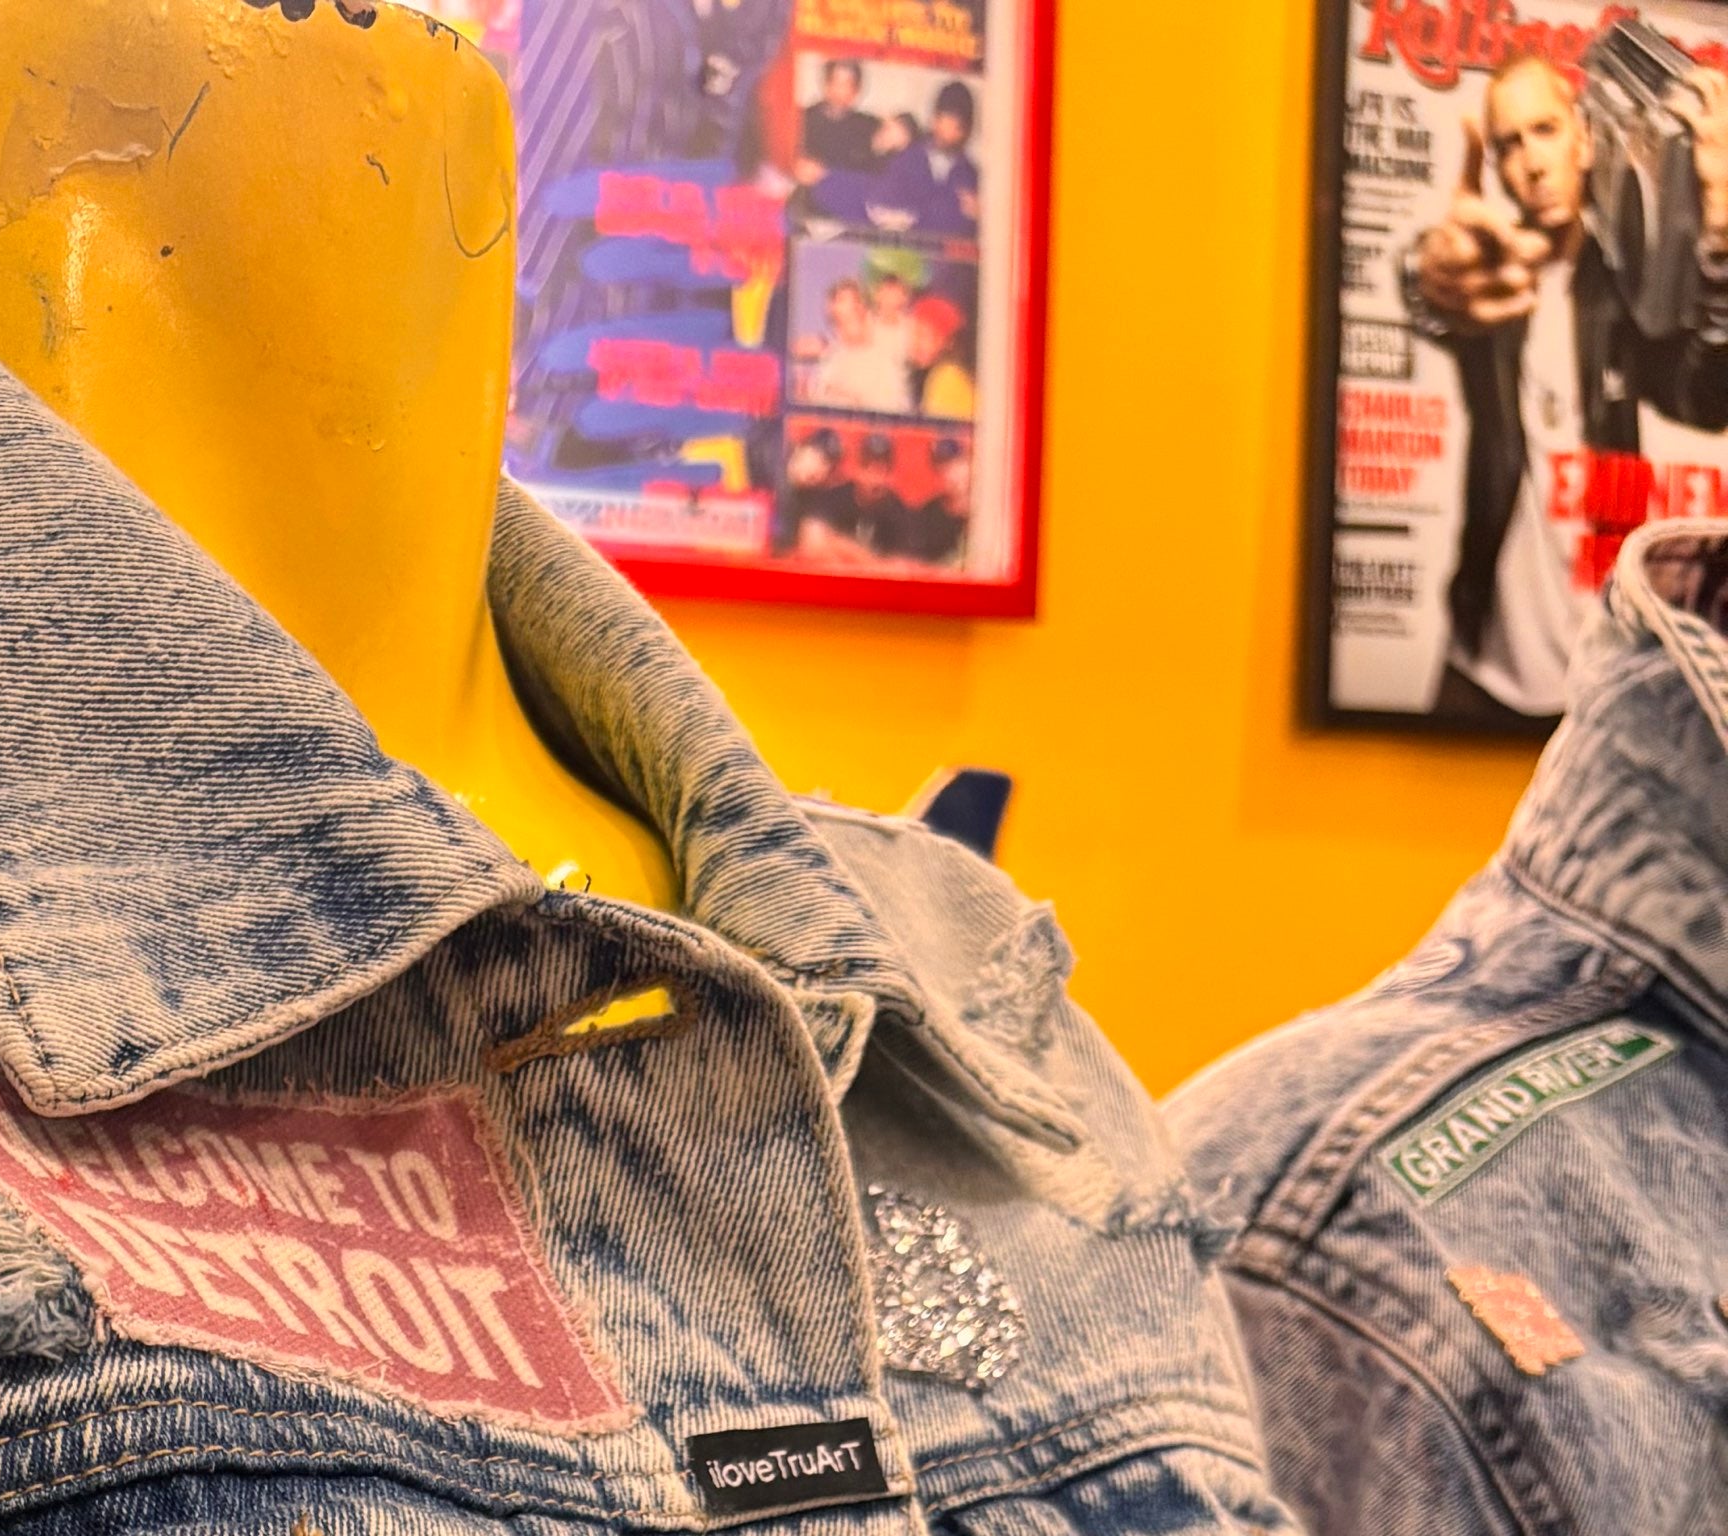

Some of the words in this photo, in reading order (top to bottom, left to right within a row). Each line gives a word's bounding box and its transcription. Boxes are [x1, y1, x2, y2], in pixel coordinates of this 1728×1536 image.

[1399, 1079, 1534, 1188] GRAND
[336, 1145, 460, 1241] TO
[51, 1193, 544, 1389] DETROIT
